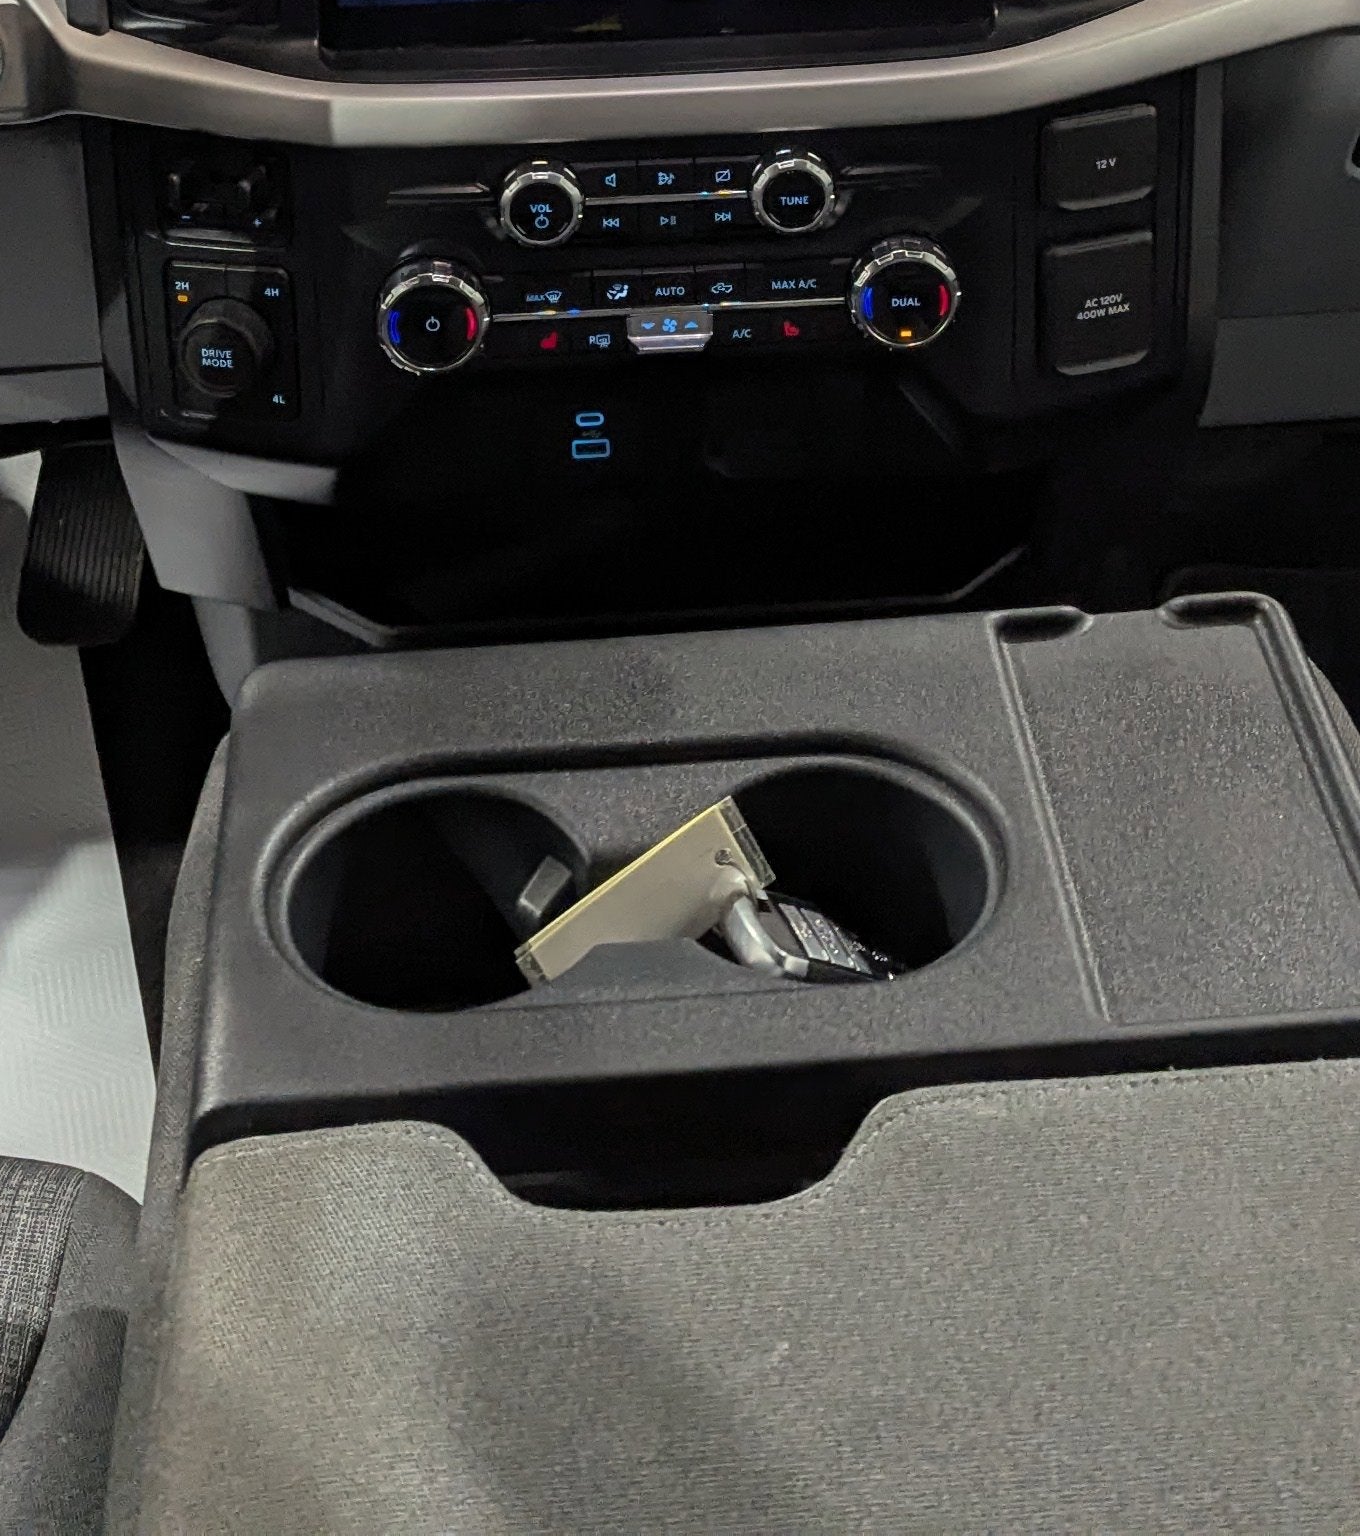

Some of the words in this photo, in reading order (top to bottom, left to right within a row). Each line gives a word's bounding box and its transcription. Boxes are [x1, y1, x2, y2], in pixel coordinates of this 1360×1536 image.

[779, 194, 810, 207] TUNE
[529, 203, 553, 214] VOL
[174, 280, 191, 292] 2H
[771, 279, 797, 291] MAX
[798, 278, 818, 290] A/C
[263, 287, 280, 297] 4H
[654, 286, 686, 298] AUTO
[890, 296, 922, 308] DUAL
[1084, 297, 1099, 309] AC
[1100, 293, 1123, 307] 120V
[1076, 307, 1107, 321] 400W
[1108, 302, 1131, 316] MAX
[731, 327, 753, 340] A/C
[201, 347, 233, 359] DRIVE
[201, 357, 235, 369] MODE
[272, 394, 287, 405] 4L
